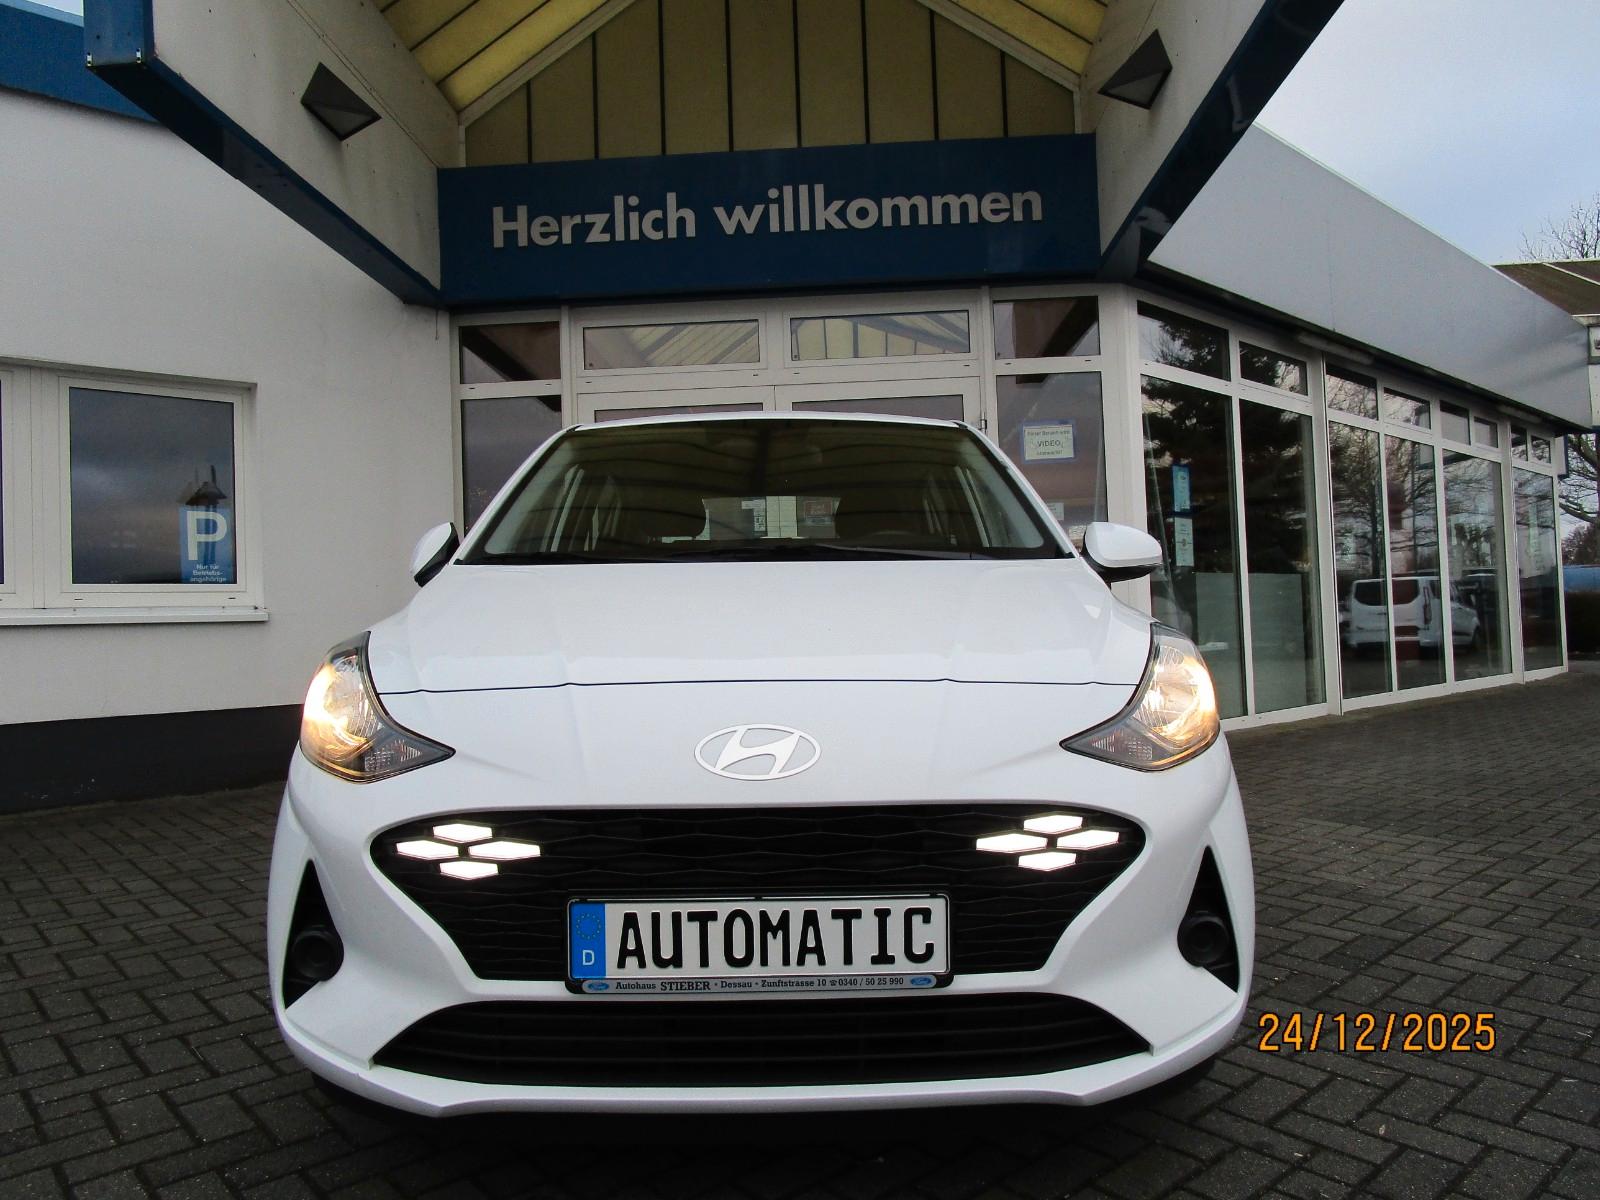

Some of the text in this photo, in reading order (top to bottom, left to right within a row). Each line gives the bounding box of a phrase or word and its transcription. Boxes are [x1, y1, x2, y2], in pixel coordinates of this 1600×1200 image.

[492, 183, 1043, 249] Herzlich willkommen
[187, 510, 227, 560] P
[582, 949, 595, 966] D
[616, 907, 935, 969] AUTOMATIC
[615, 981, 656, 990] Autohaus
[660, 980, 711, 991] STIEBER
[720, 980, 752, 989] Dessau
[761, 978, 815, 988] Zunftstrasse
[817, 978, 827, 987] 10
[838, 977, 857, 986] 0340
[865, 977, 875, 986] 50
[877, 977, 887, 986] 25
[889, 977, 904, 985] 990
